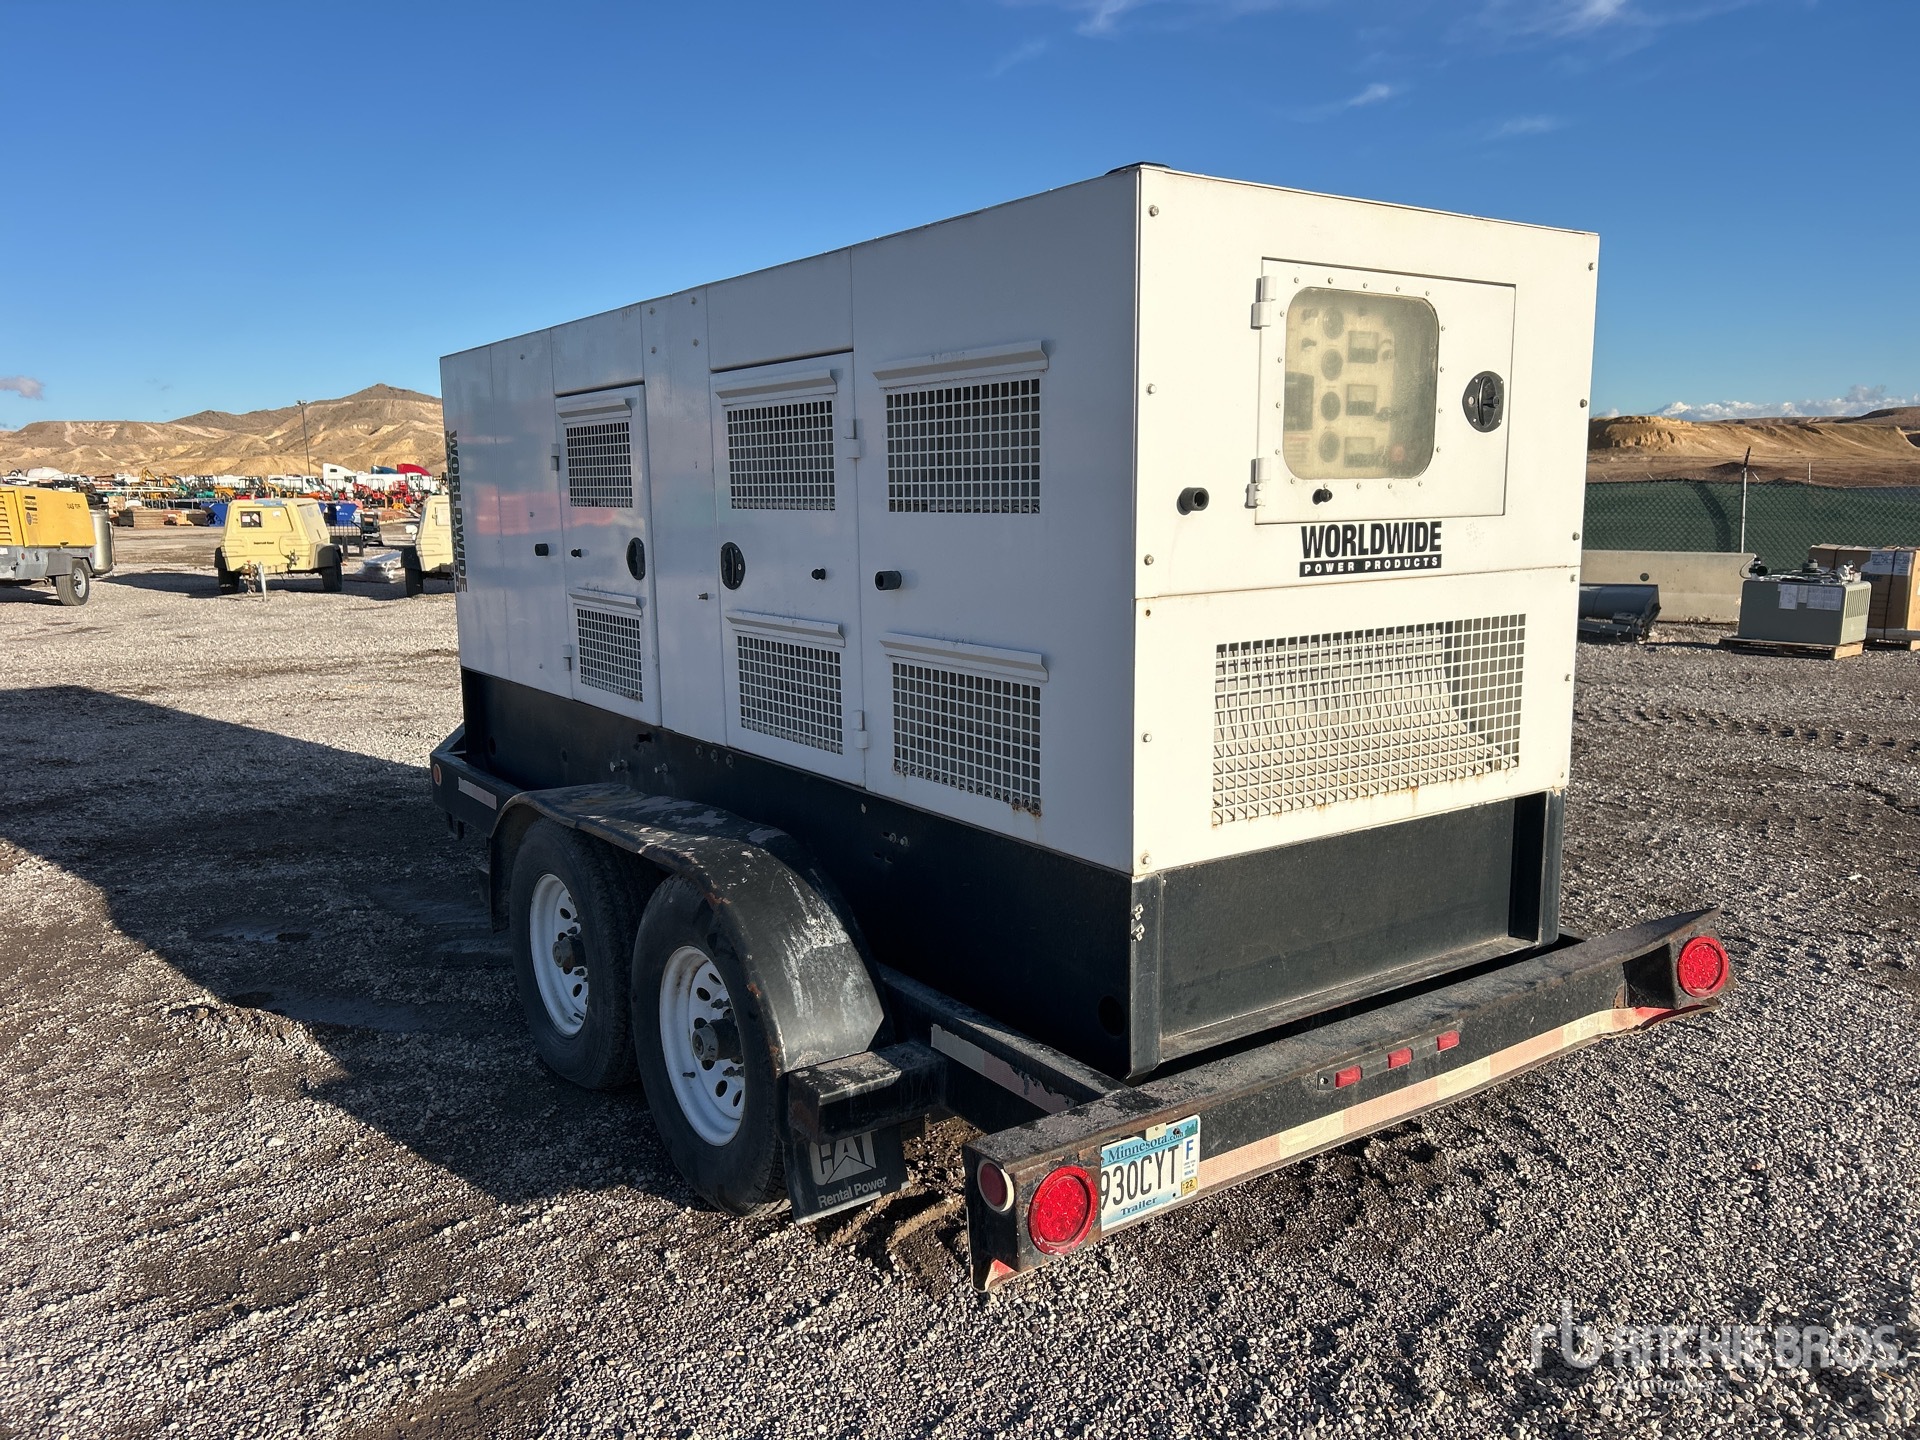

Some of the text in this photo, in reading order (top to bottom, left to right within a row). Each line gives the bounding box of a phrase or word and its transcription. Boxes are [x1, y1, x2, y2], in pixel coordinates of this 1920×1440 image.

[449, 430, 468, 593] WORLDWIDE
[1301, 521, 1442, 559] WORLDWIDE
[1304, 557, 1438, 574] POWER PRODUCTS
[809, 1129, 878, 1186] CAT
[1186, 1138, 1194, 1160] F
[818, 1176, 887, 1208] Rental Power
[1185, 1180, 1194, 1189] 22
[1121, 1197, 1157, 1216] Trailer
